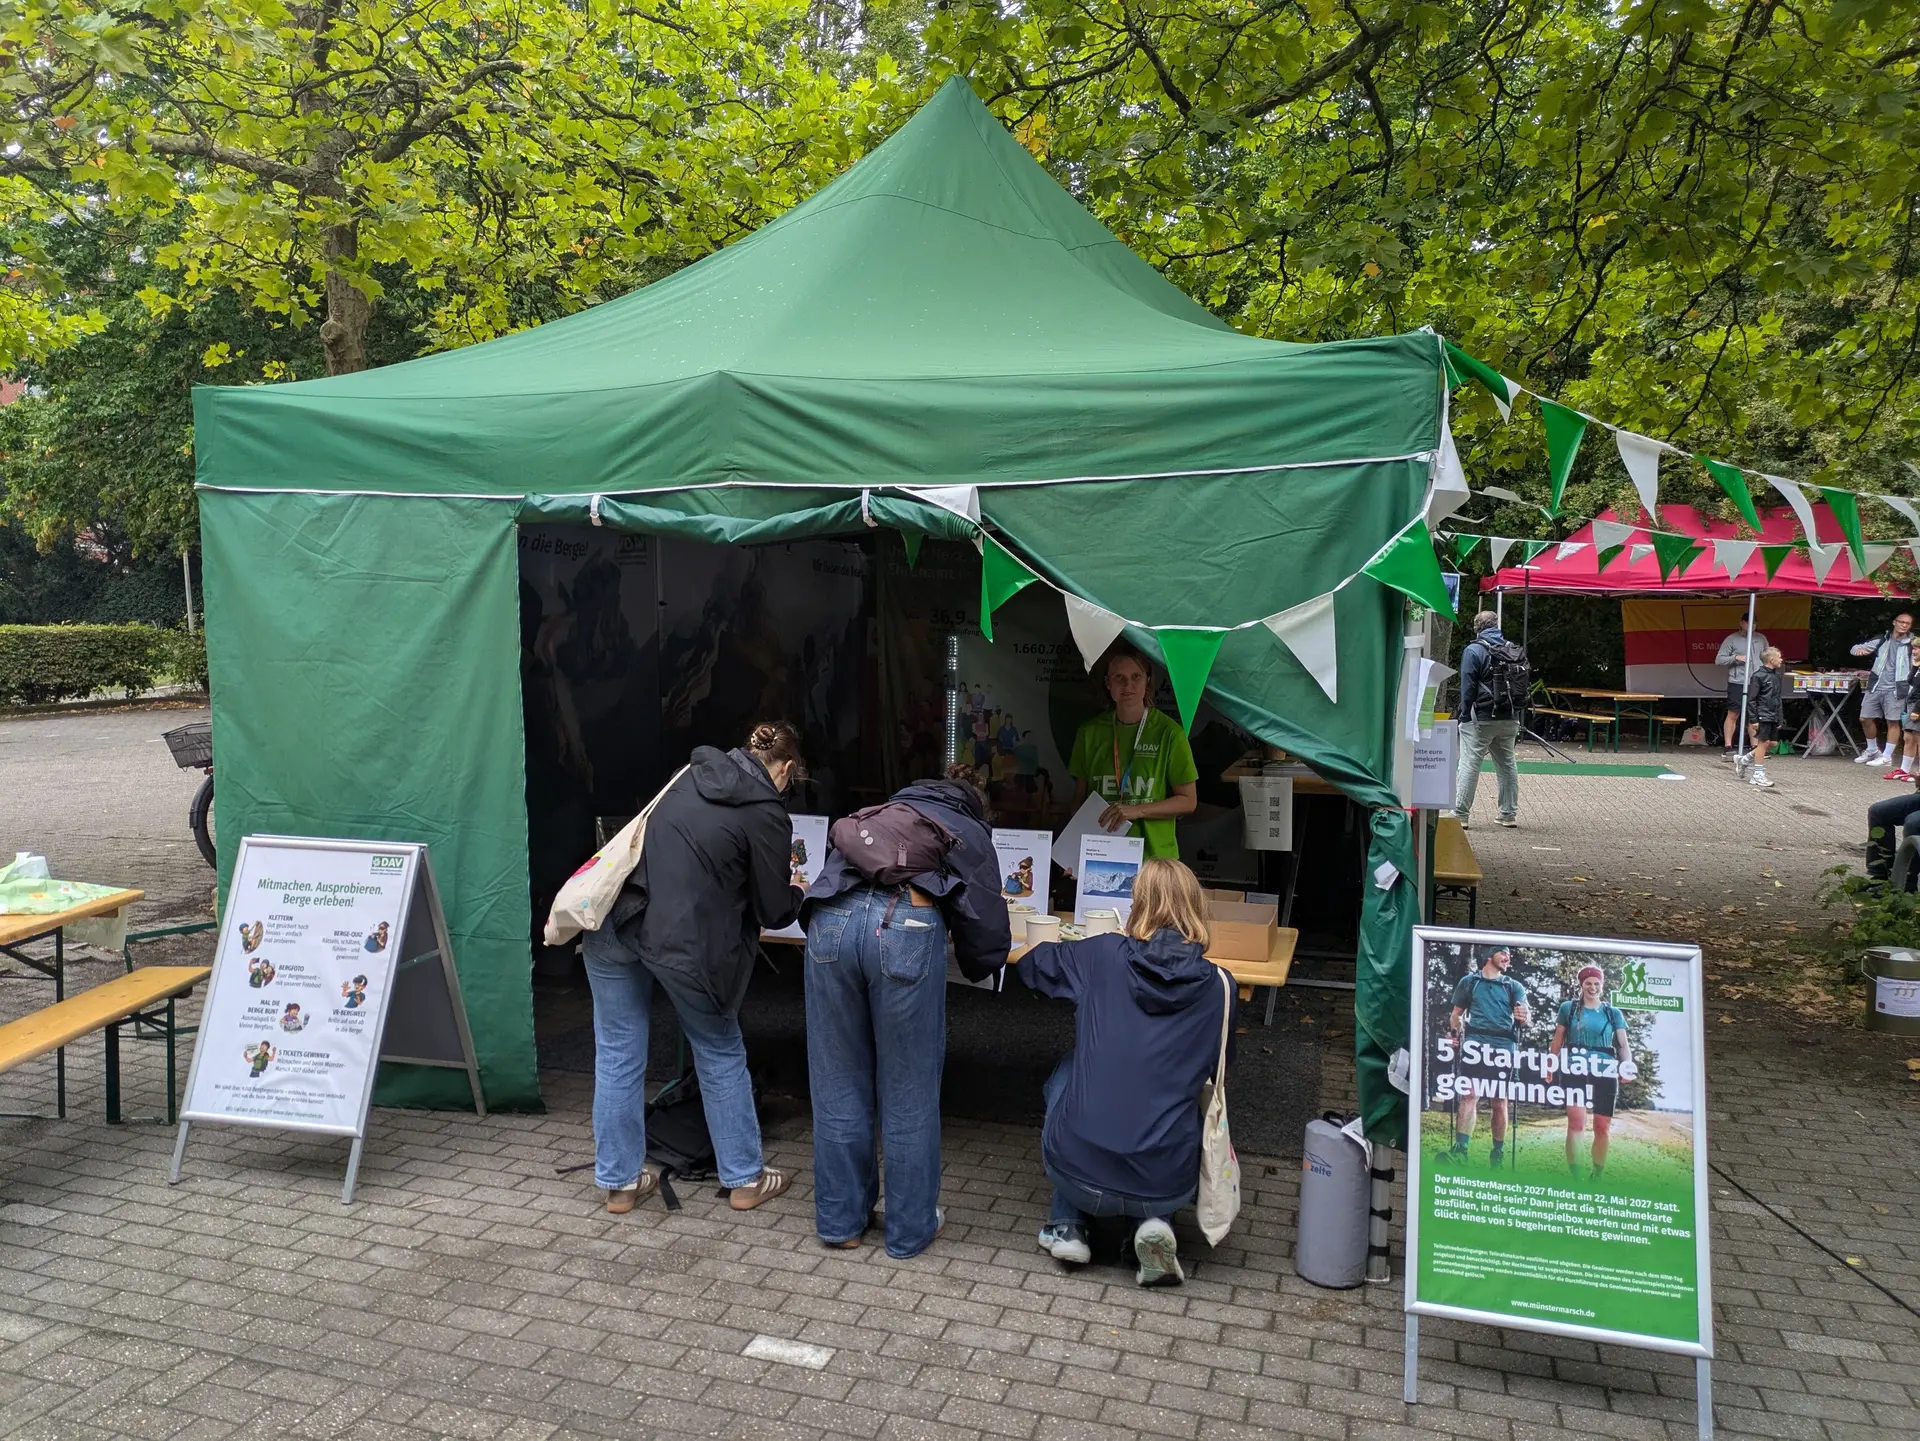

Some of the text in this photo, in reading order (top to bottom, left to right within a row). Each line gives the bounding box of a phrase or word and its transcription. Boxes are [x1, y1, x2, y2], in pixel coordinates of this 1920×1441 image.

[532, 533, 588, 561] die Berge!
[1692, 642, 1704, 650] SC
[1093, 775, 1154, 797] TEAM
[381, 858, 403, 868] DAV
[258, 879, 383, 895] Mitmachen. Ausprobieren.
[283, 894, 354, 907] Berge erleben!
[333, 1009, 366, 1017] VR-BERGWELT
[1437, 1038, 1638, 1080] 5 Startplätze
[1435, 1072, 1594, 1109] gewinnen!
[1435, 1174, 1450, 1183] Der
[1453, 1176, 1522, 1192] MünsterMarsch
[1524, 1185, 1545, 1195] 2027
[1547, 1187, 1575, 1199] findet
[1594, 1194, 1608, 1203] 22.
[1610, 1196, 1627, 1205] Mai
[1630, 1198, 1651, 1208] 2027
[1654, 1202, 1680, 1212] statt.
[1435, 1186, 1672, 1223] Du willst dabei sein? Dann jetzt die Teilnahmekarte
[1434, 1198, 1691, 1238] ausfüllen, in die Gewinnspielbox werfen und mit etwas
[1434, 1208, 1459, 1220] Glück
[1462, 1212, 1486, 1223] eines
[1507, 1218, 1513, 1226] 5
[1516, 1219, 1563, 1233] begehrten
[1566, 1226, 1599, 1238] Tickets
[1601, 1231, 1651, 1245] gewinnen.
[1433, 1252, 1455, 1260] ausgelost
[1466, 1256, 1501, 1265] benachrichtigt.
[1512, 1262, 1537, 1270] Rechtsweg
[1545, 1267, 1584, 1276] ausgeschlossen.
[1601, 1274, 1621, 1282] Rahmen
[1632, 1278, 1665, 1288] Gewinnspiels
[1666, 1283, 1694, 1291] erhobenen
[1489, 1251, 1525, 1260] Teilnahmekarte
[1526, 1255, 1548, 1263] ausfüllen
[1560, 1260, 1581, 1269] abgeben.
[1592, 1265, 1615, 1273] Gewinner
[1616, 1267, 1634, 1275] werden
[1661, 1274, 1683, 1283] NRW-Tag
[1511, 1300, 1596, 1318] www.münstermarsch.de
